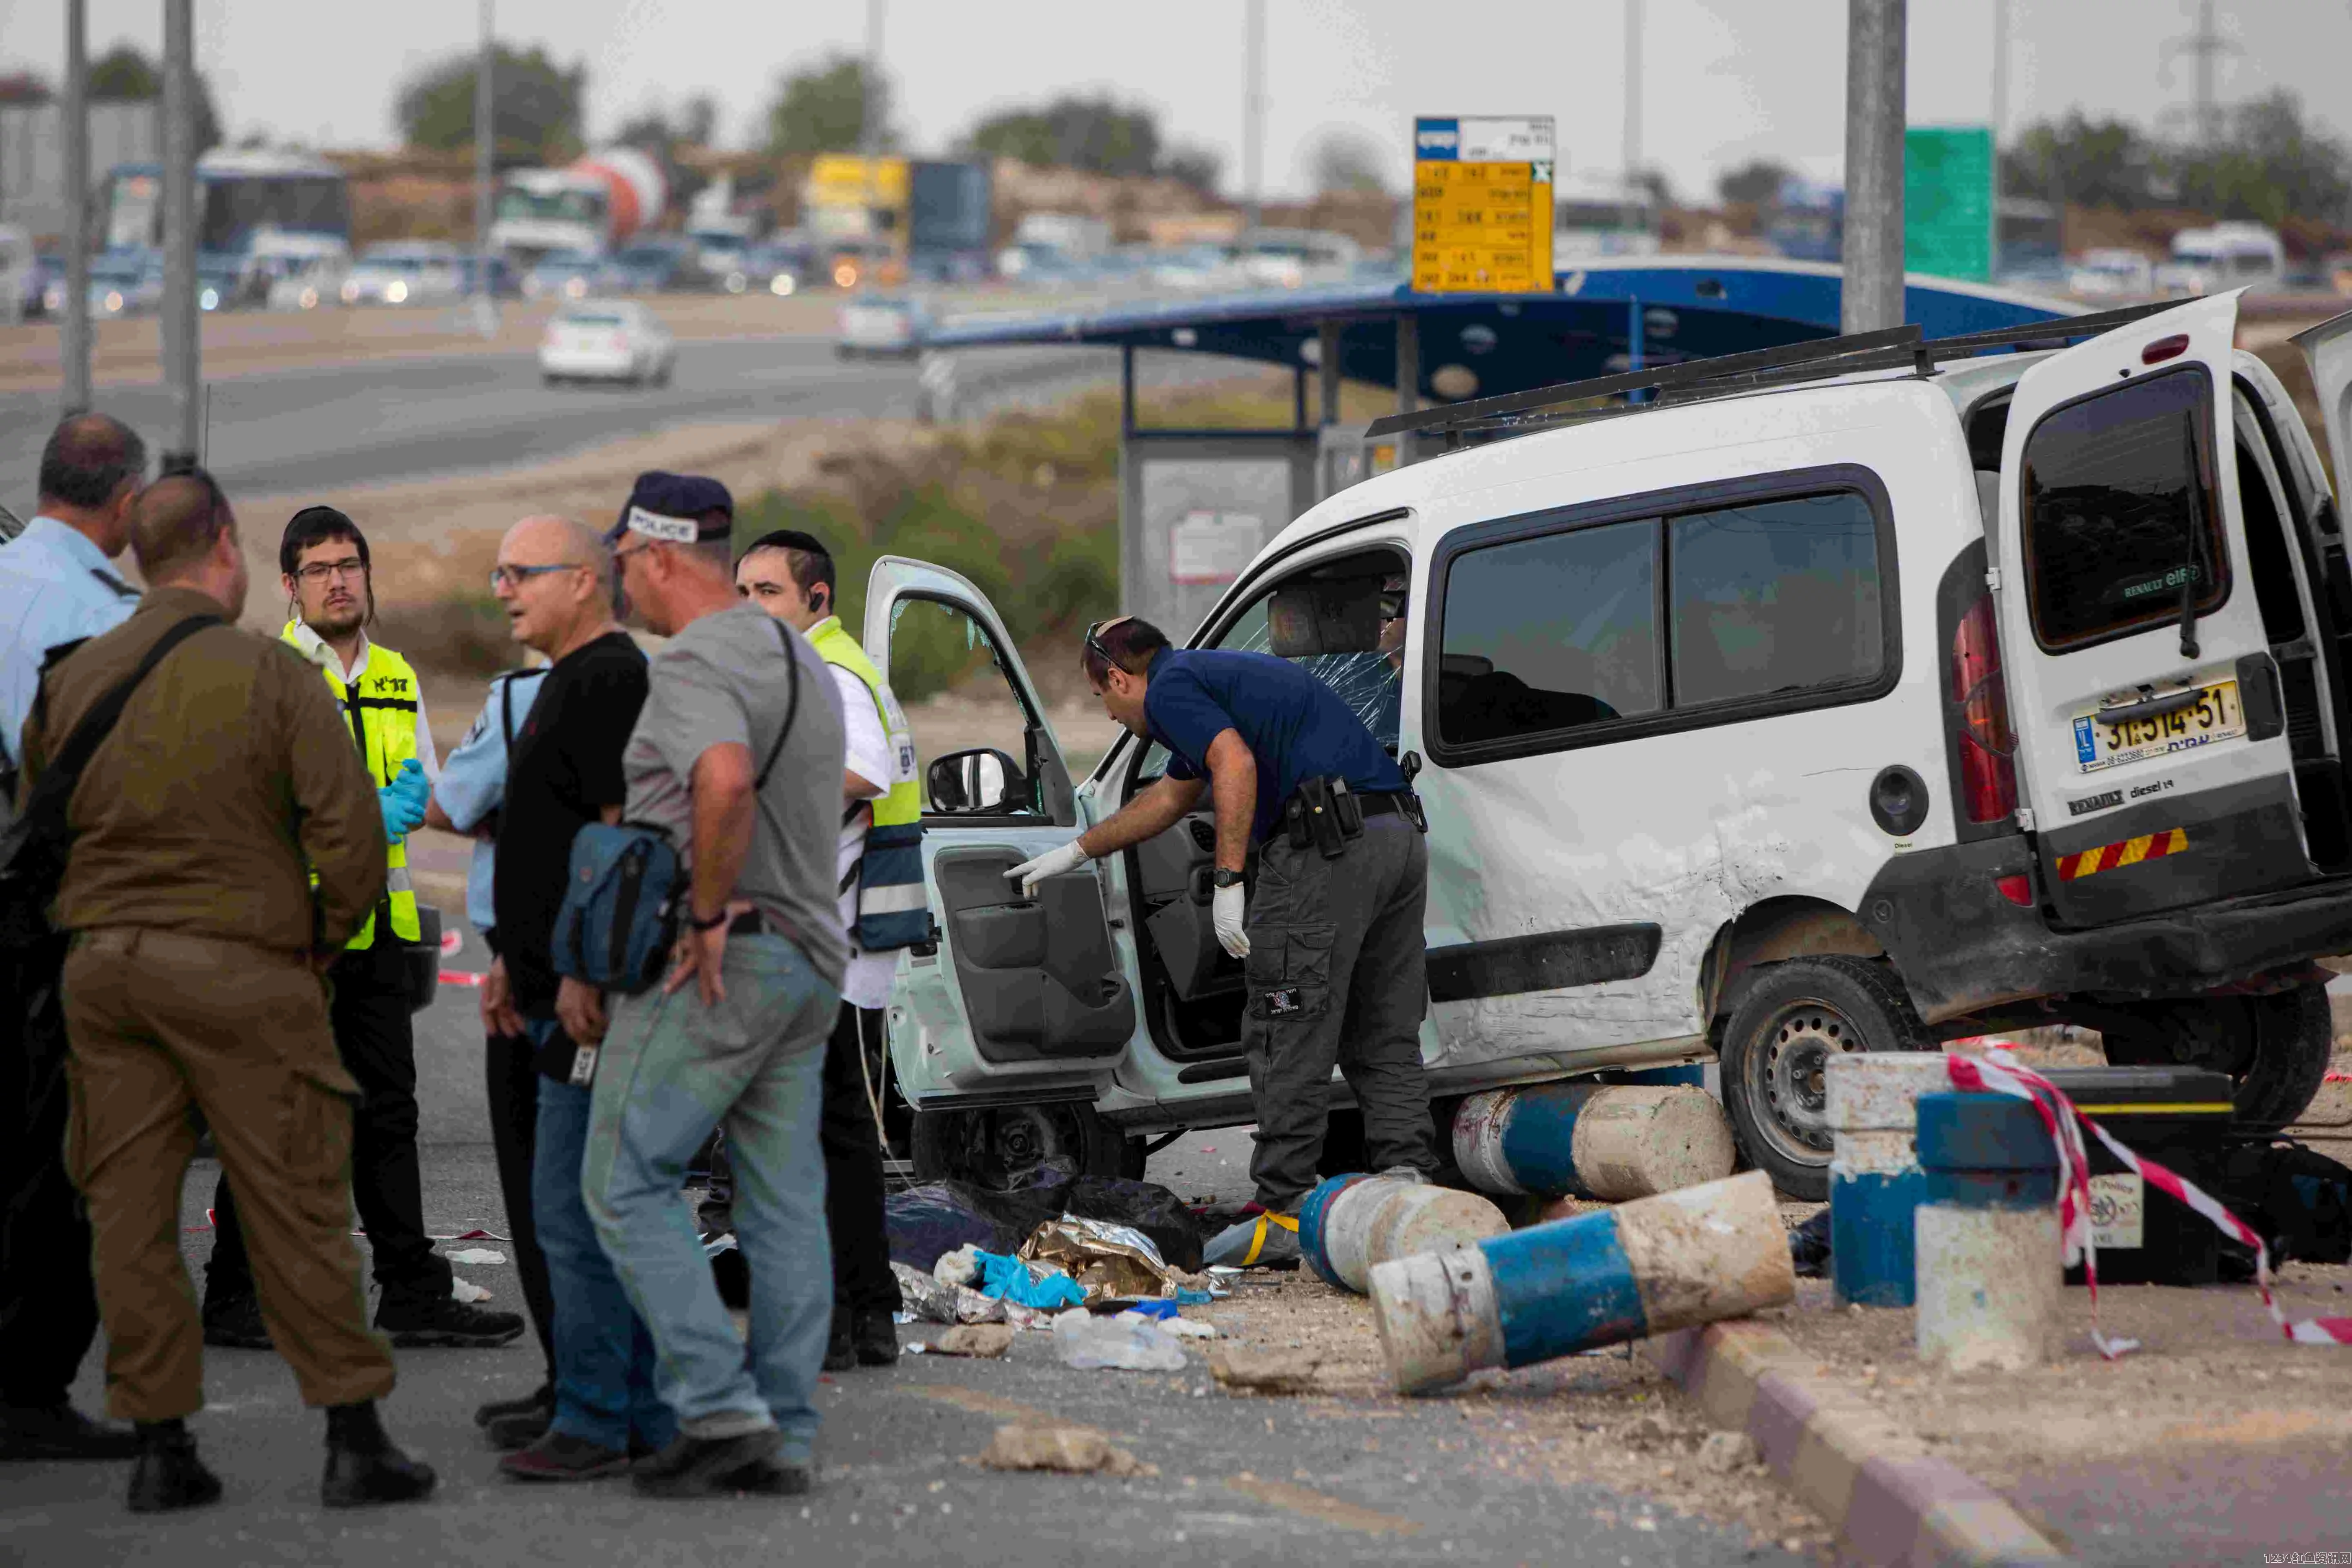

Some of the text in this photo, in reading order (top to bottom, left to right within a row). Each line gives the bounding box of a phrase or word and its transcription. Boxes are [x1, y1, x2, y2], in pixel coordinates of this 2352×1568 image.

[634, 514, 689, 537] POLICE
[2124, 568, 2187, 598] RENAULT elf
[2067, 790, 2125, 816] RENAULT
[2130, 781, 2161, 798] diesel
